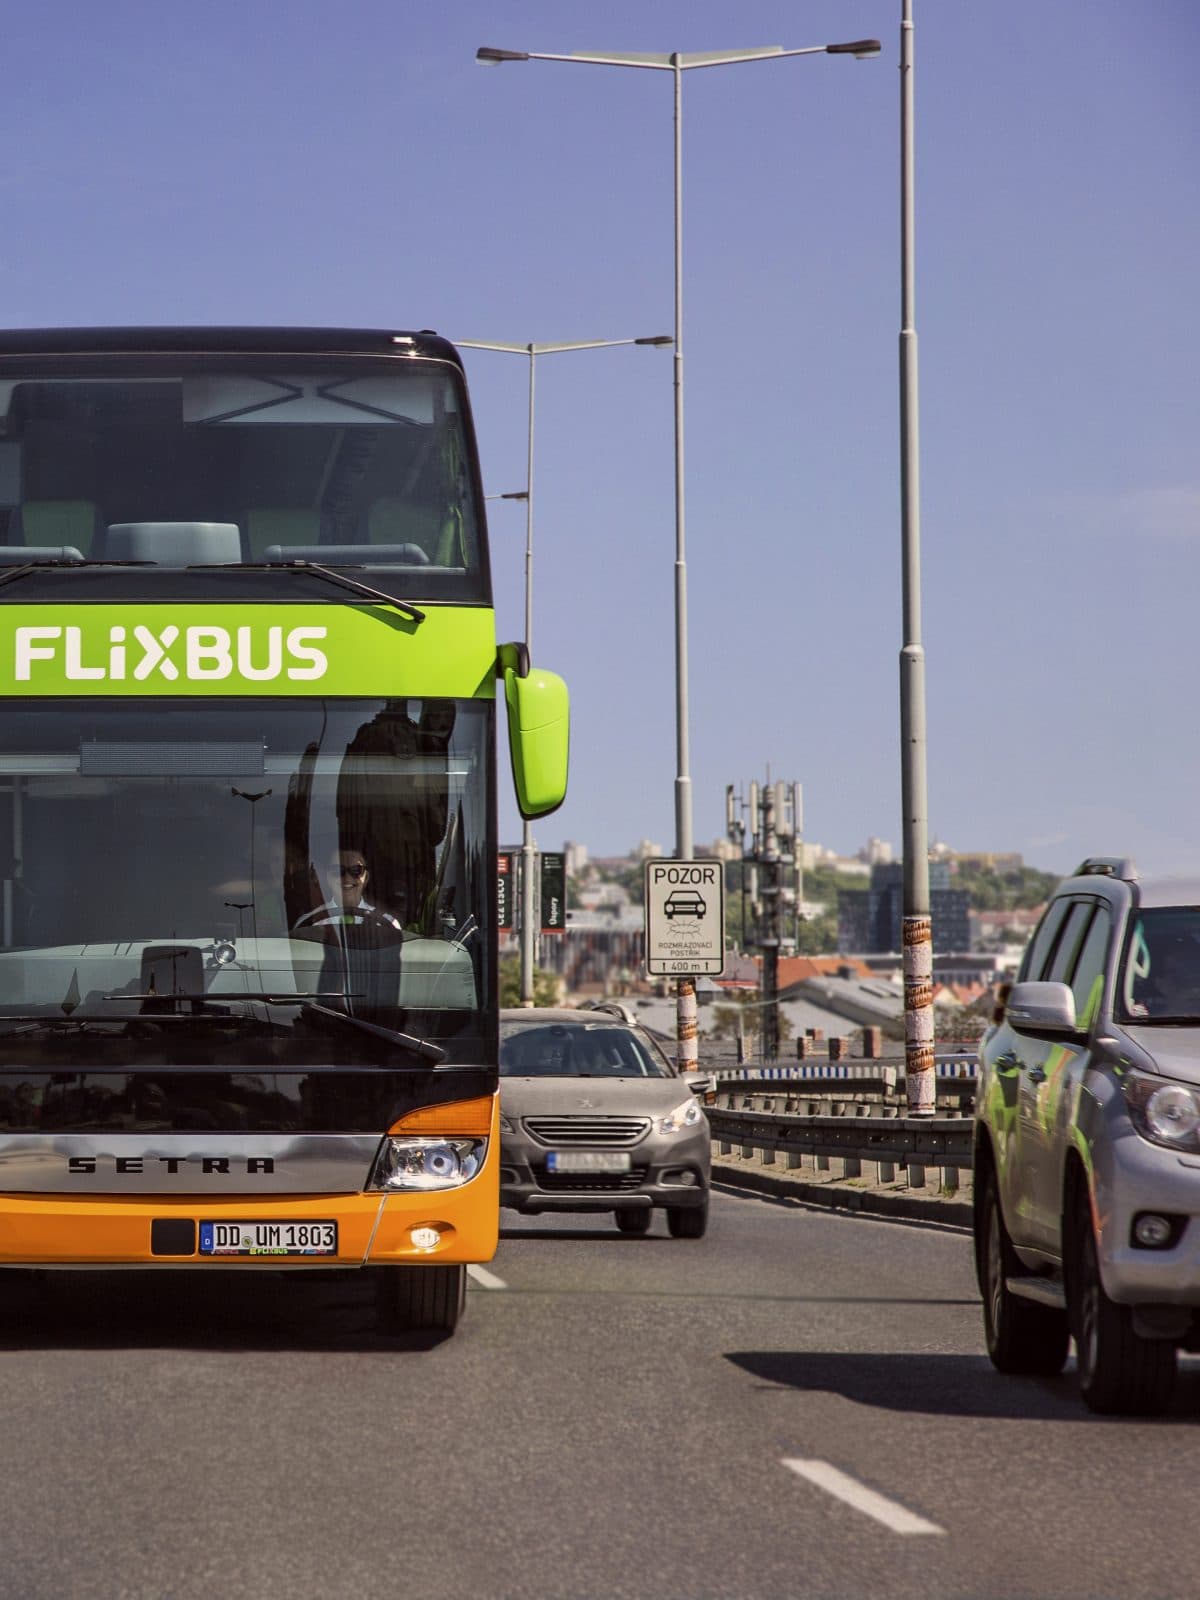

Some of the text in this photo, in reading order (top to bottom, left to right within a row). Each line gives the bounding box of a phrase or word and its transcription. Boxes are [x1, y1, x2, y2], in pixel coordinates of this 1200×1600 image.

[654, 867, 715, 885] POZOR
[671, 962, 689, 971] 400
[69, 1157, 274, 1174] SETRA
[216, 1225, 334, 1247] DD UM 1803
